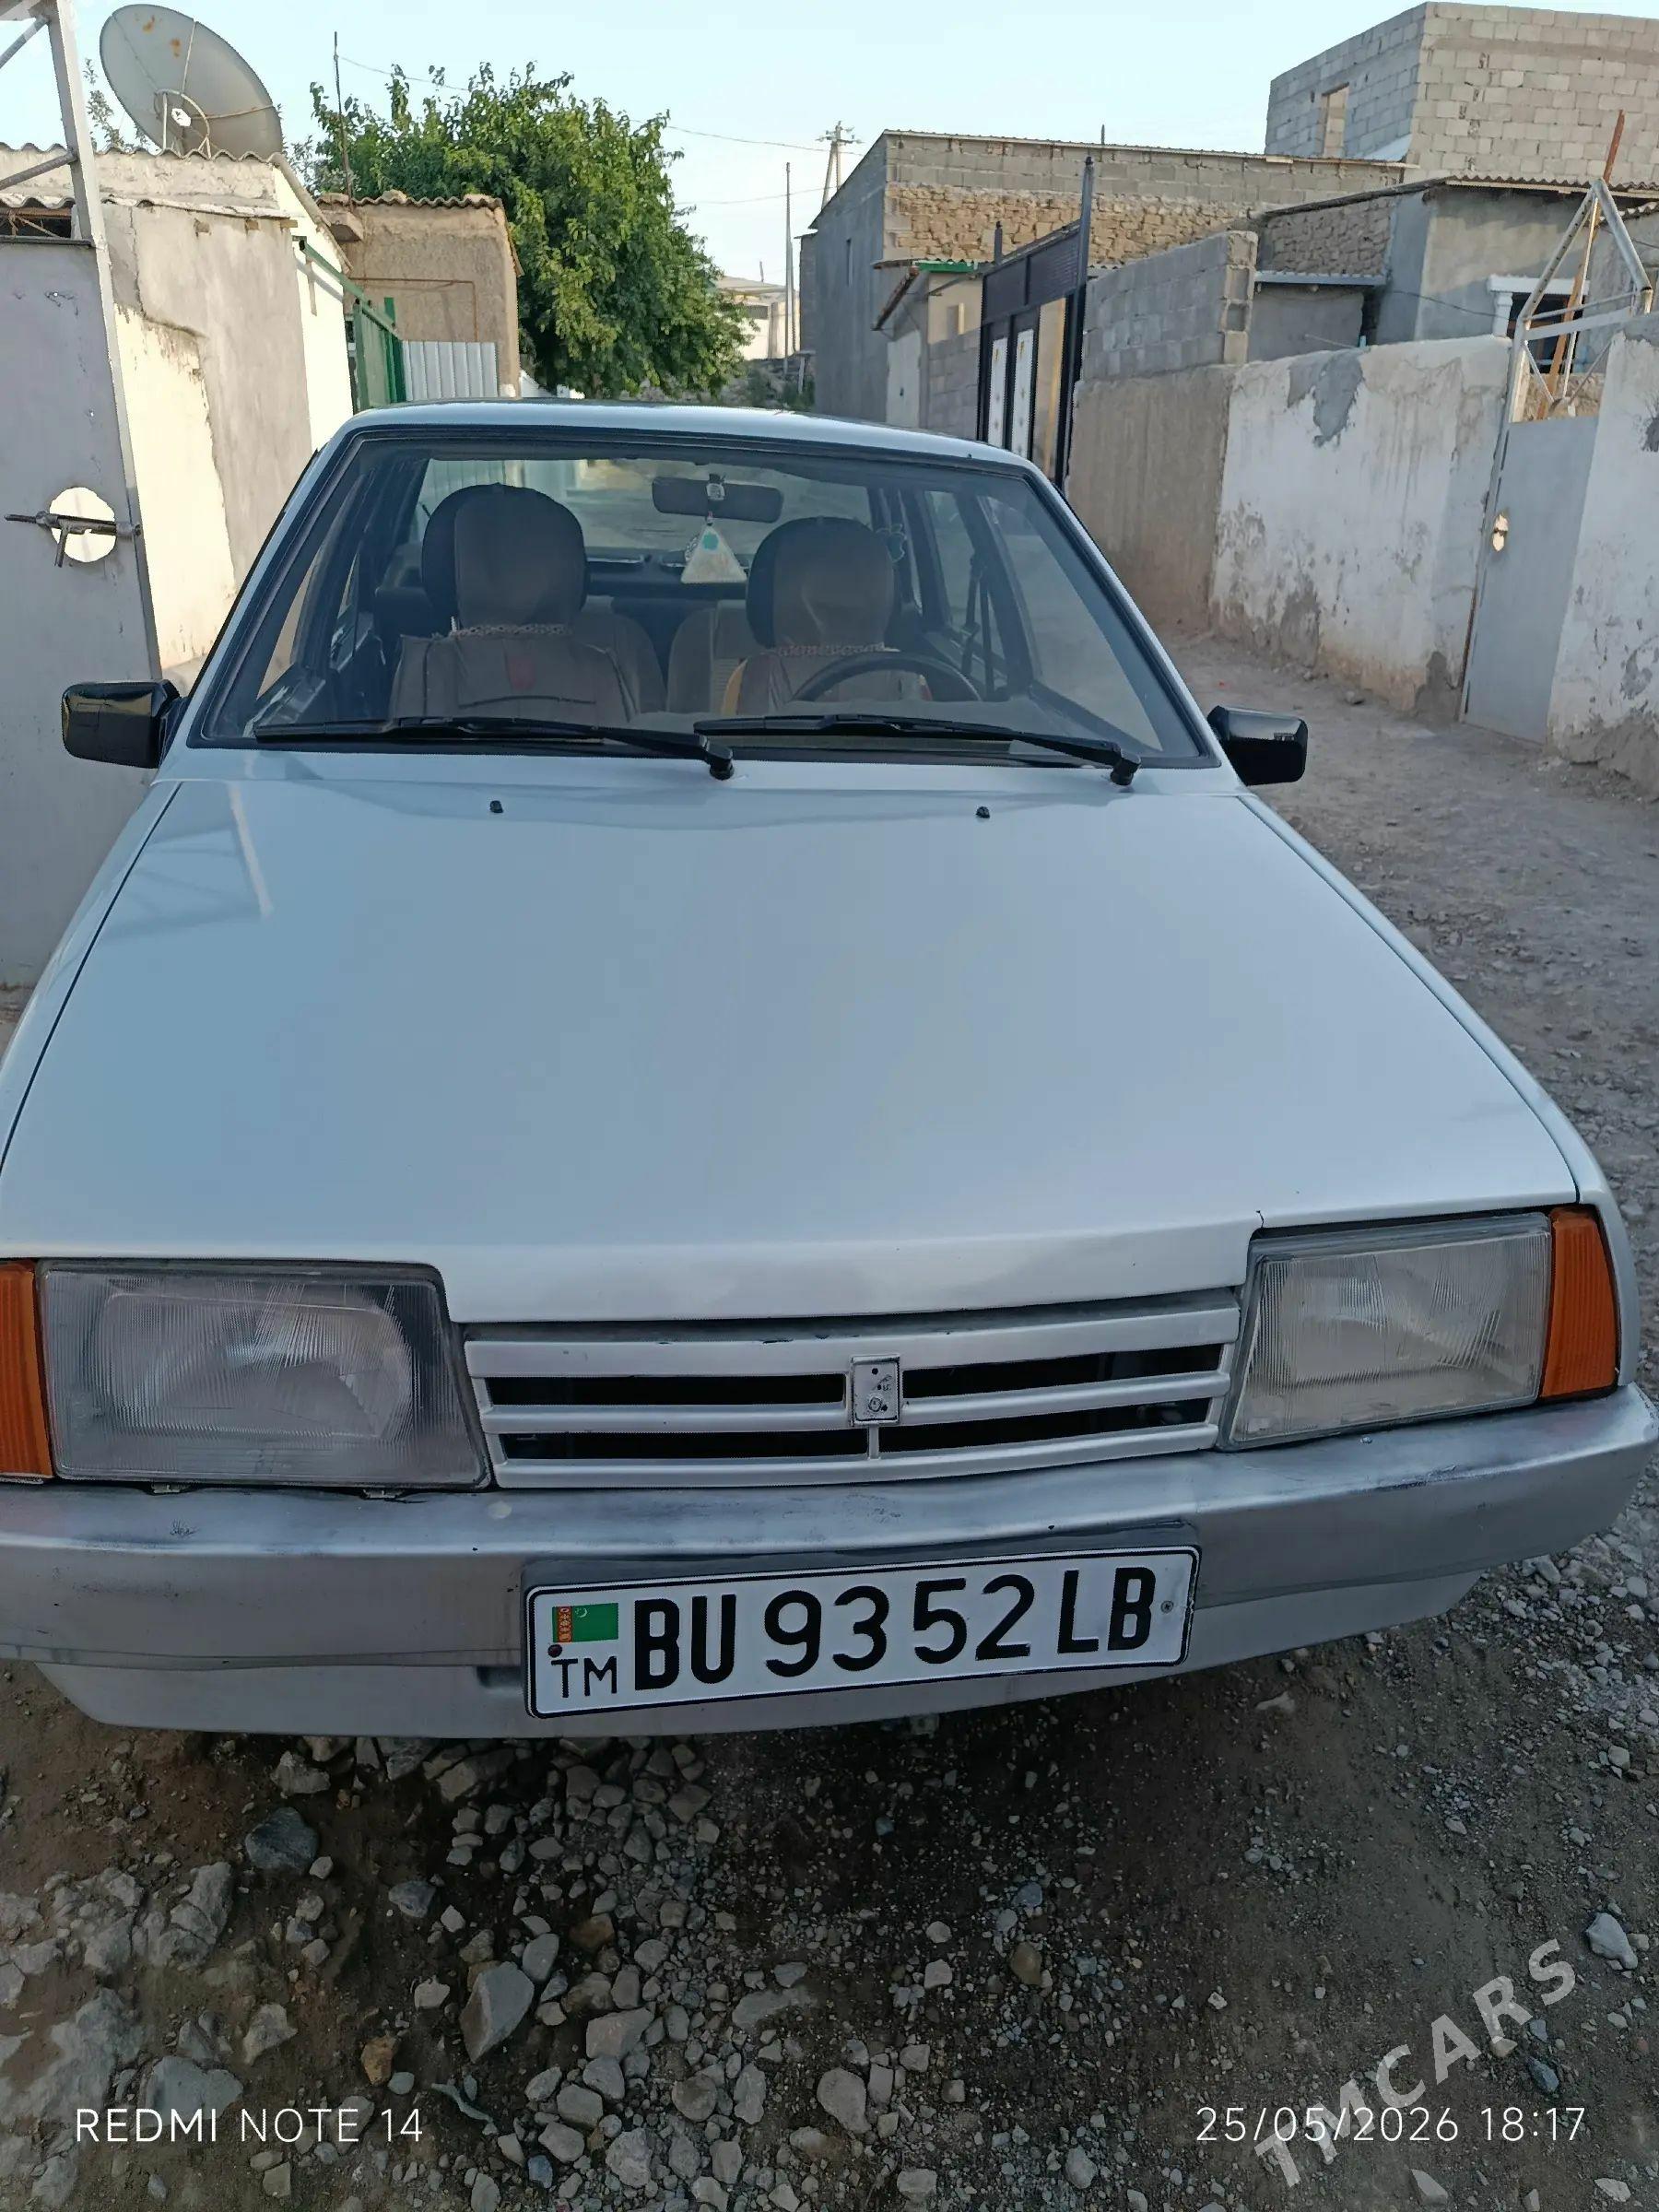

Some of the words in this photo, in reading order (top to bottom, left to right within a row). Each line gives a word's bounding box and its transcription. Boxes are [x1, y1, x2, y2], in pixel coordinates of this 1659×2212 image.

[633, 1594, 737, 1692] BU
[1056, 1566, 1157, 1657] LB
[550, 1655, 618, 1699] TM
